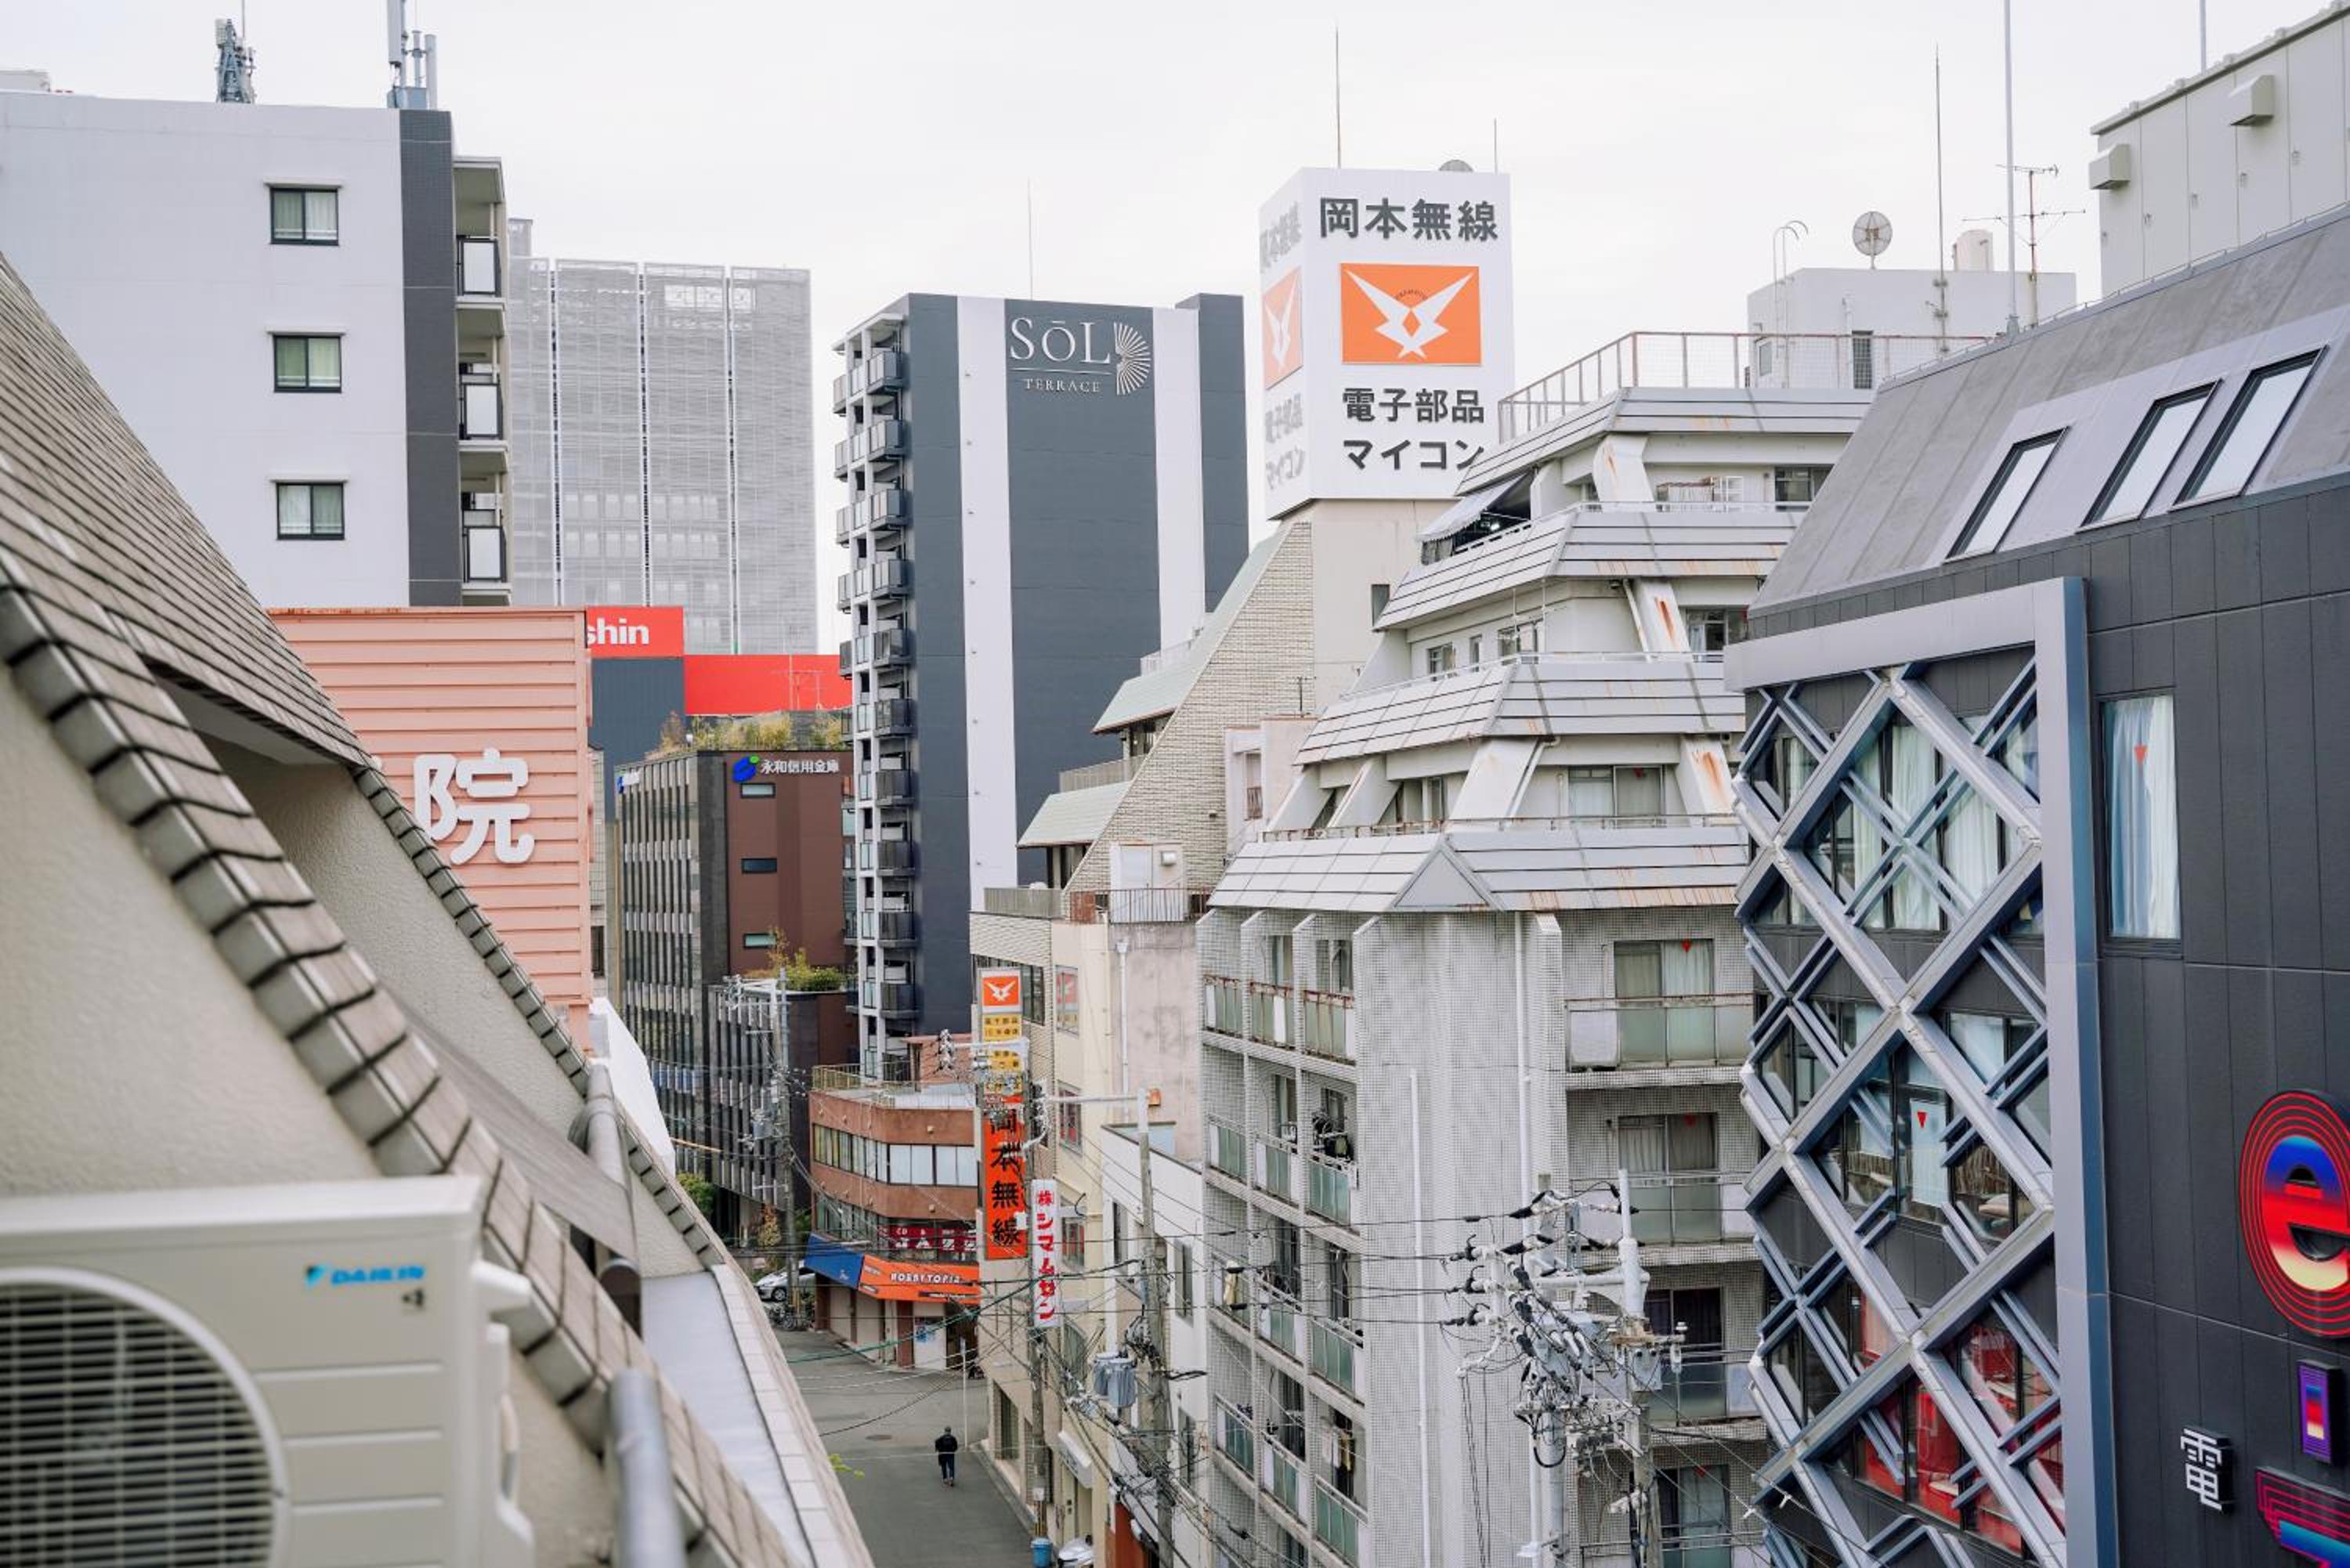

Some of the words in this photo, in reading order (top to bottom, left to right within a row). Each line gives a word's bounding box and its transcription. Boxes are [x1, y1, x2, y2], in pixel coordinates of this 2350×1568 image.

[1320, 197, 1499, 242] 岡本無線
[1022, 378, 1102, 392] TERRACE
[1343, 387, 1485, 424] 電子部品
[1343, 439, 1485, 470] マイコン
[414, 746, 535, 865] 院
